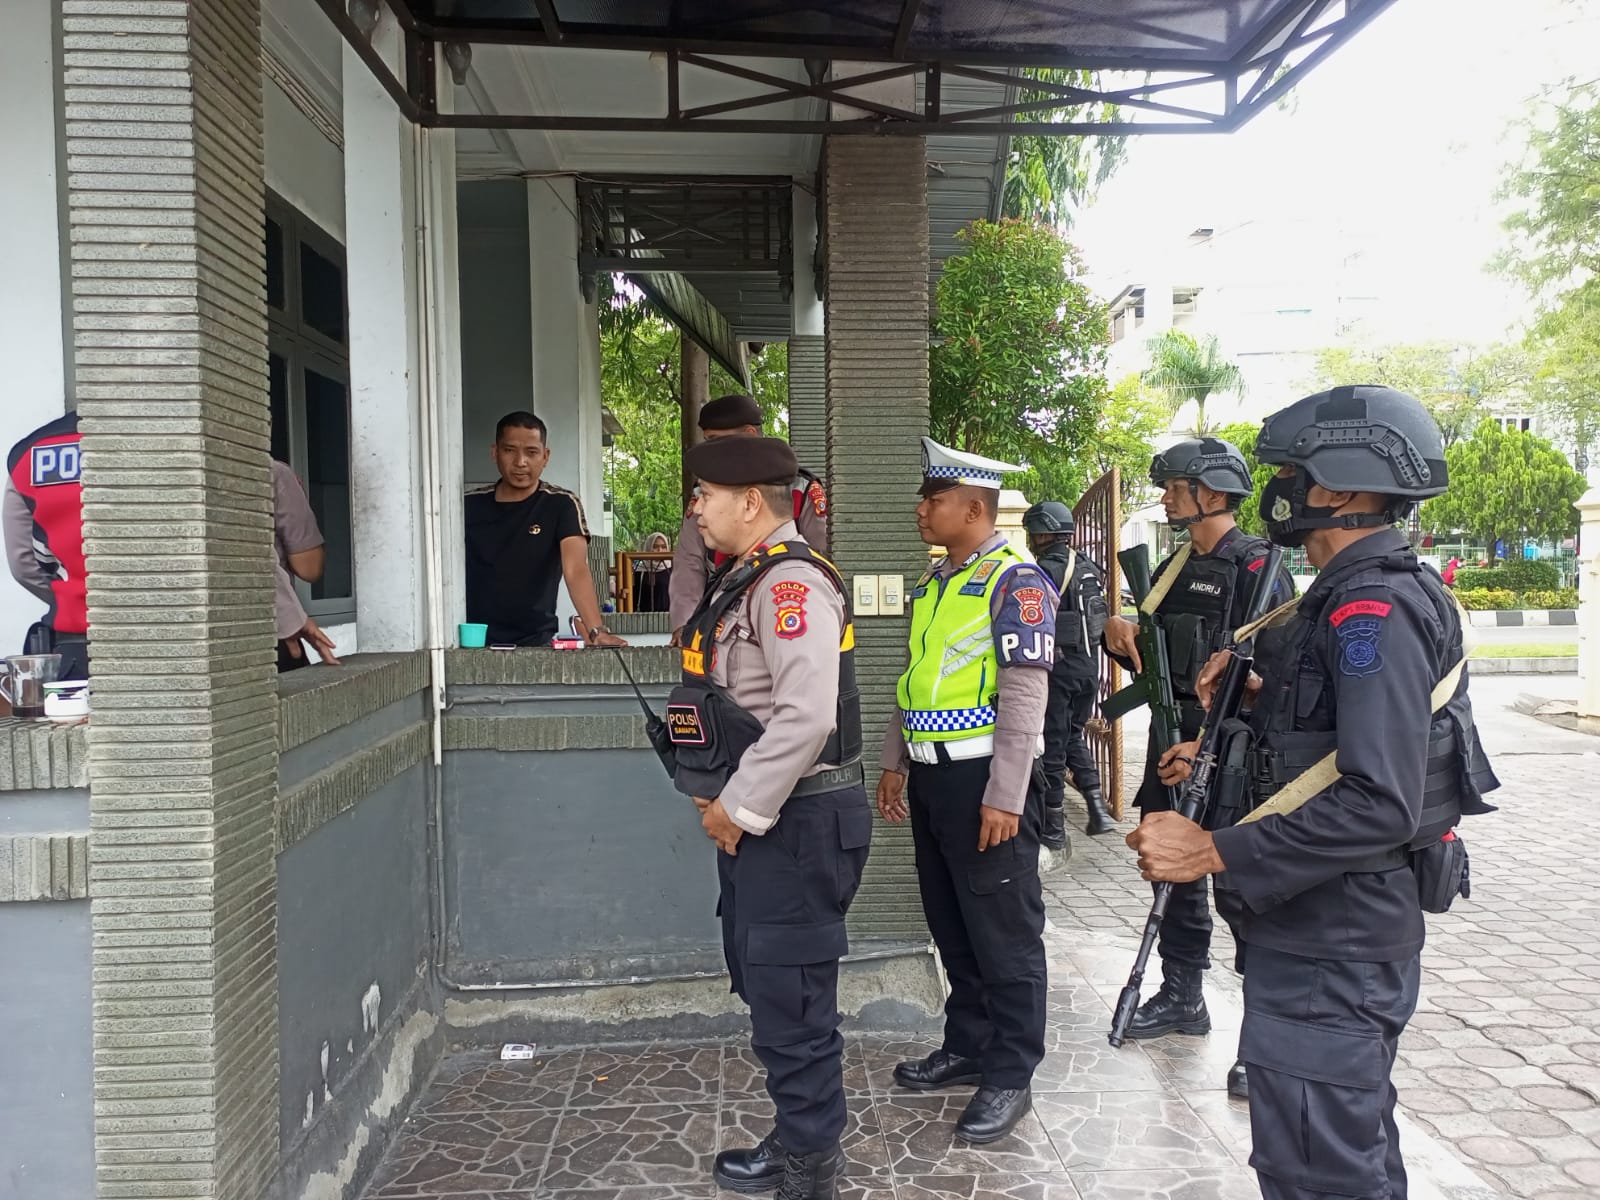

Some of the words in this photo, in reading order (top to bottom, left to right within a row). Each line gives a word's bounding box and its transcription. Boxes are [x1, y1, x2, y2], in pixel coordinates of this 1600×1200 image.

[775, 583, 805, 593] POLDA
[1017, 588, 1042, 597] POLDA
[1190, 581, 1214, 594] ANDRI
[1214, 586, 1221, 595] J
[1001, 631, 1055, 665] PJR
[669, 713, 698, 726] POLISI
[821, 767, 853, 785] POLRI
